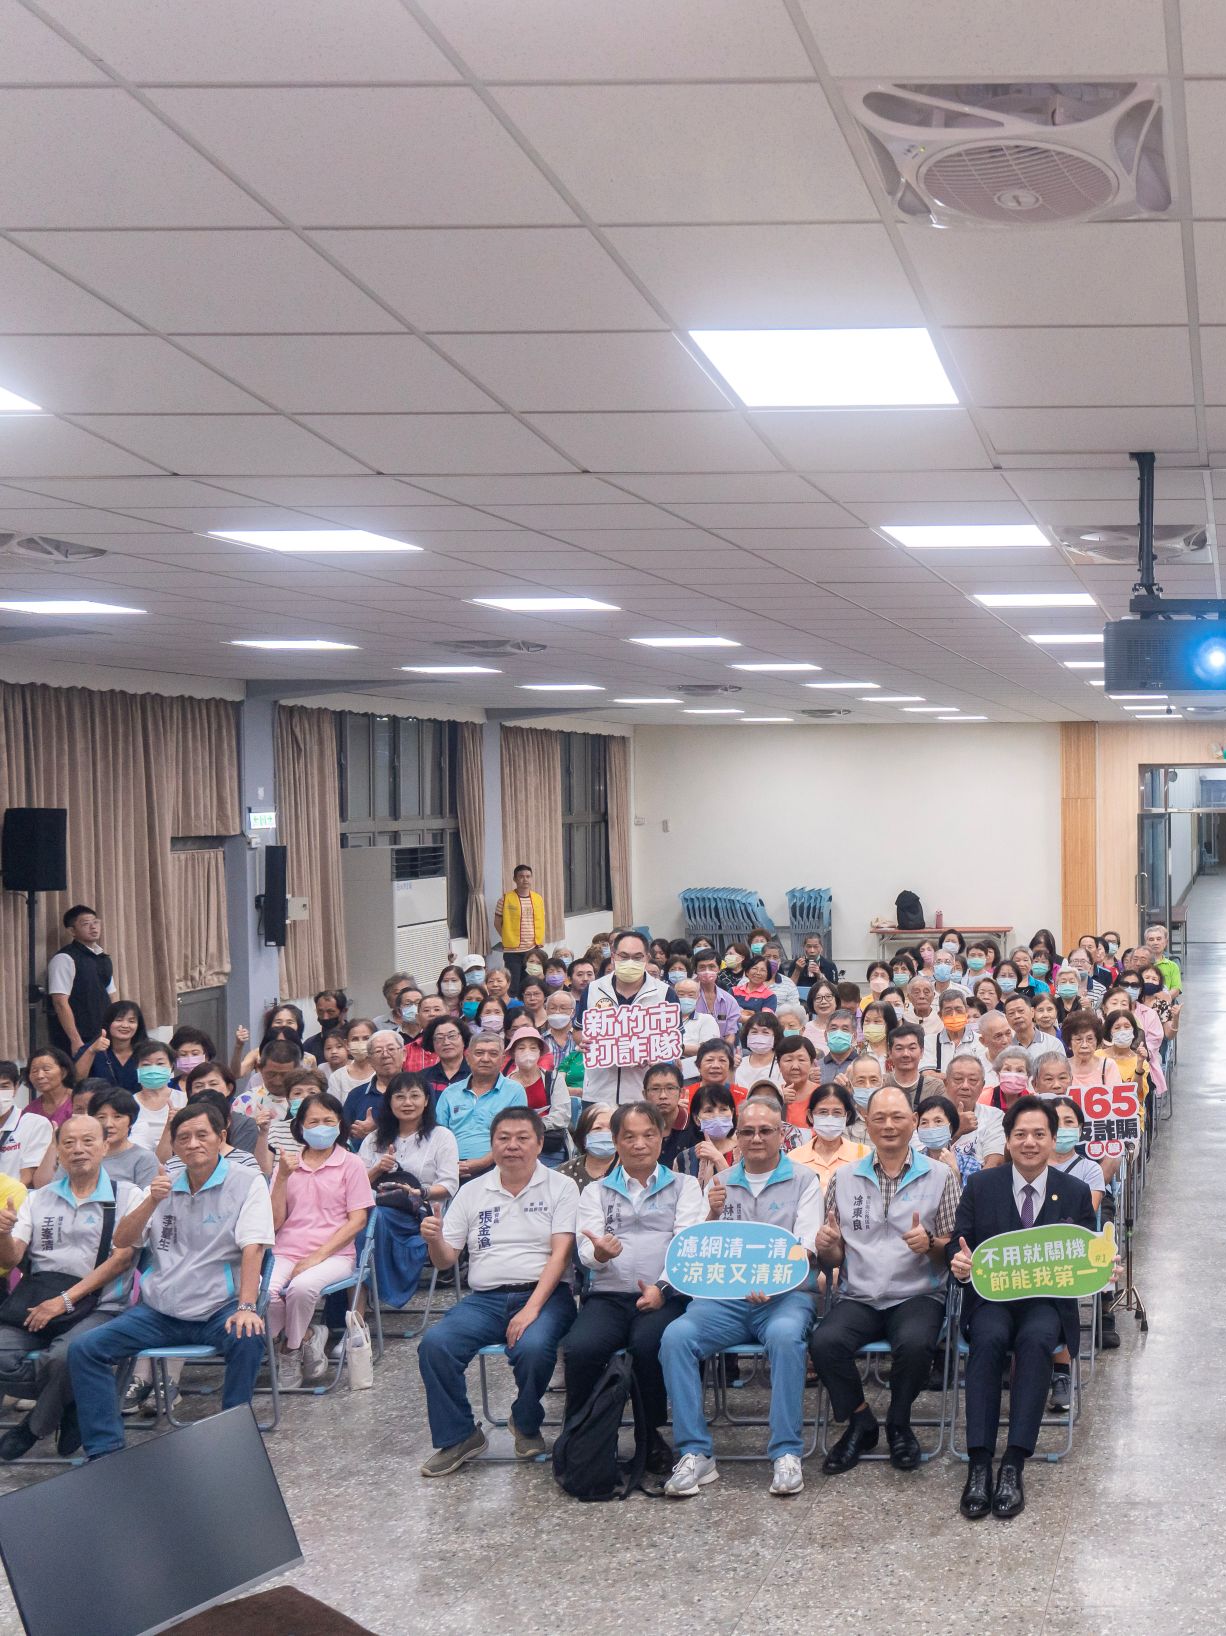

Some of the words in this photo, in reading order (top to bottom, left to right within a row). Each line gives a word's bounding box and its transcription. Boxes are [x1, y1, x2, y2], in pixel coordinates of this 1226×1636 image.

[585, 1002, 678, 1037] 新竹市
[585, 1031, 681, 1067] 打詐隊
[1068, 1085, 1137, 1119] 165
[677, 1236, 788, 1259] 濾網清一清
[980, 1238, 1086, 1269] 不用就關機
[1095, 1254, 1107, 1264] #1
[683, 1261, 793, 1285] 涼爽又清新
[990, 1265, 1098, 1292] 節能我第一
